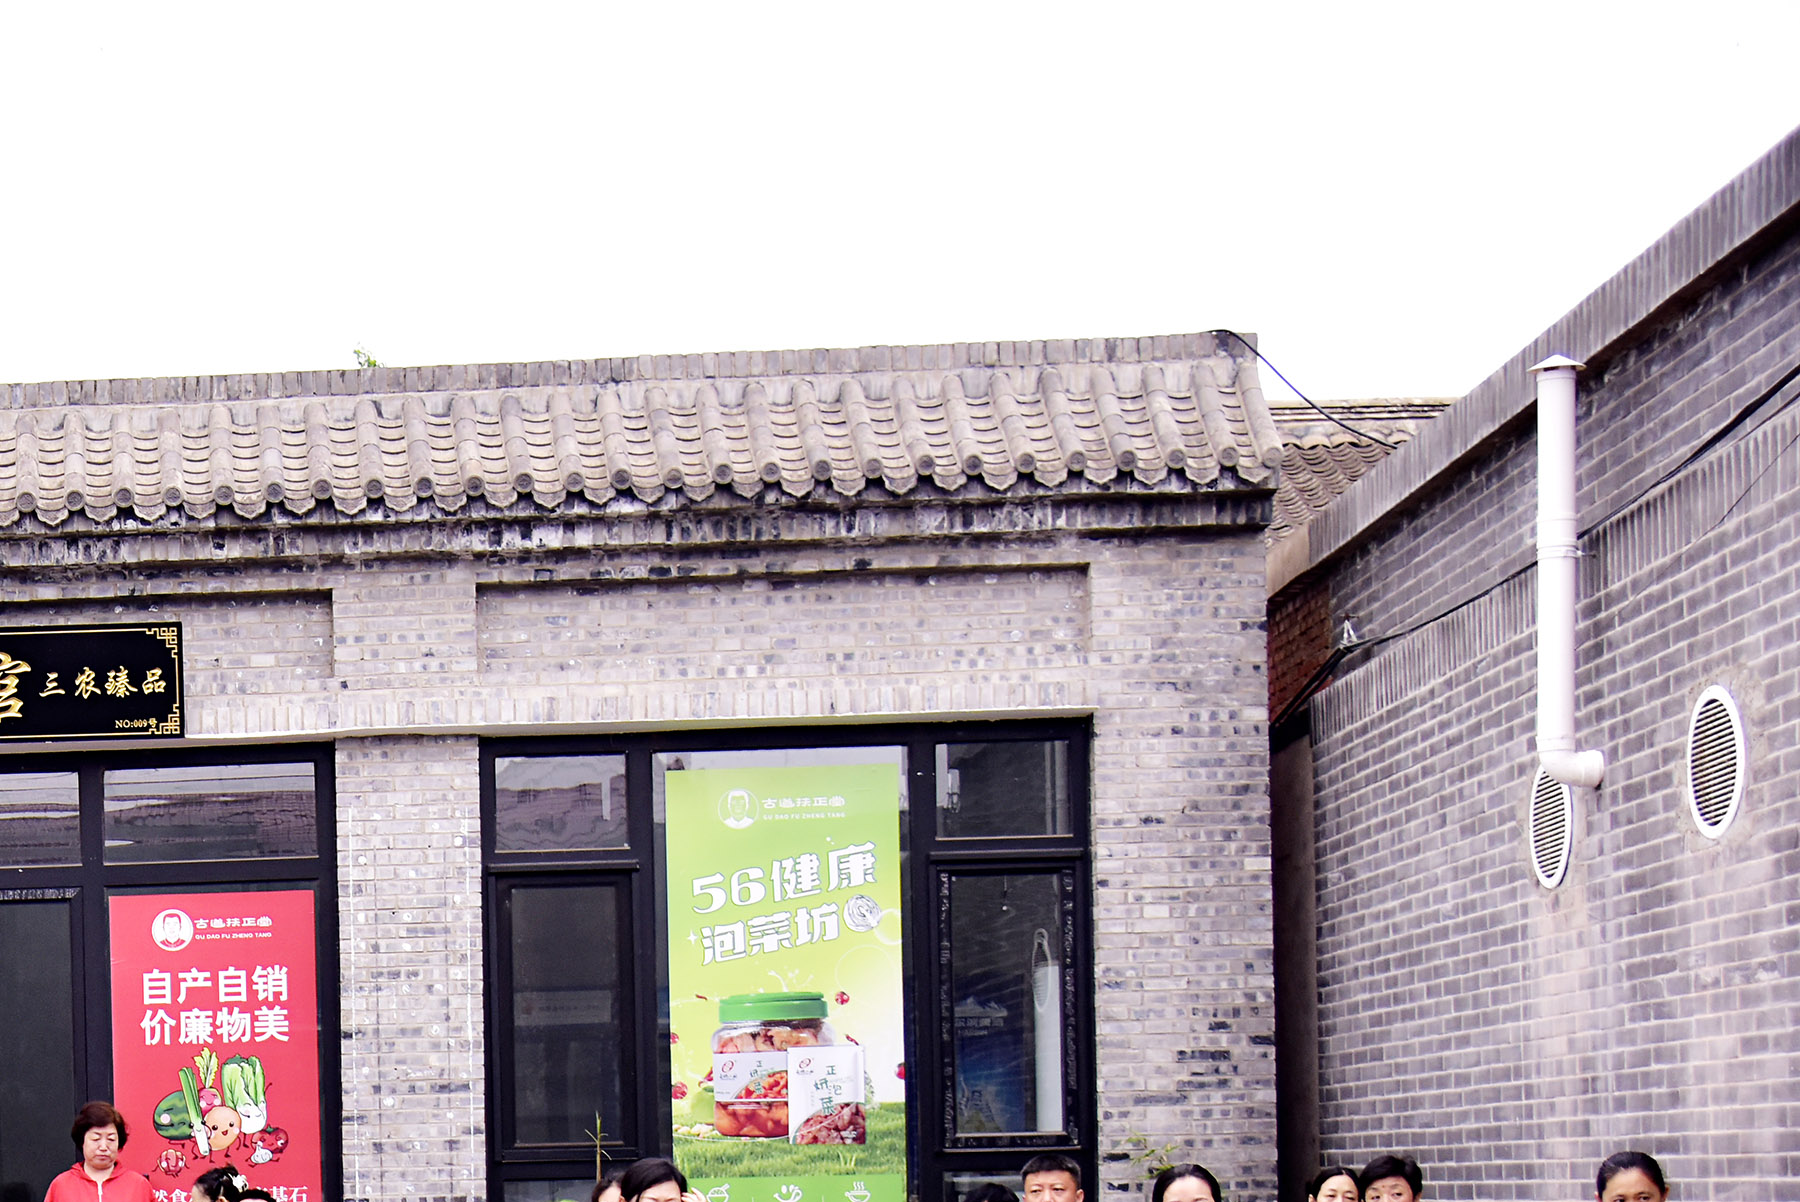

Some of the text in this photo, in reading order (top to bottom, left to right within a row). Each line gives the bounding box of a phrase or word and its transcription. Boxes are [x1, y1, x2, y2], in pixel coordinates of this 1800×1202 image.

[38, 665, 167, 700] 三农臻品
[692, 840, 878, 914] 56健康
[700, 902, 840, 967] 泡菜坊
[142, 964, 289, 1005] 自产自销
[140, 1005, 290, 1046] 价廉物美
